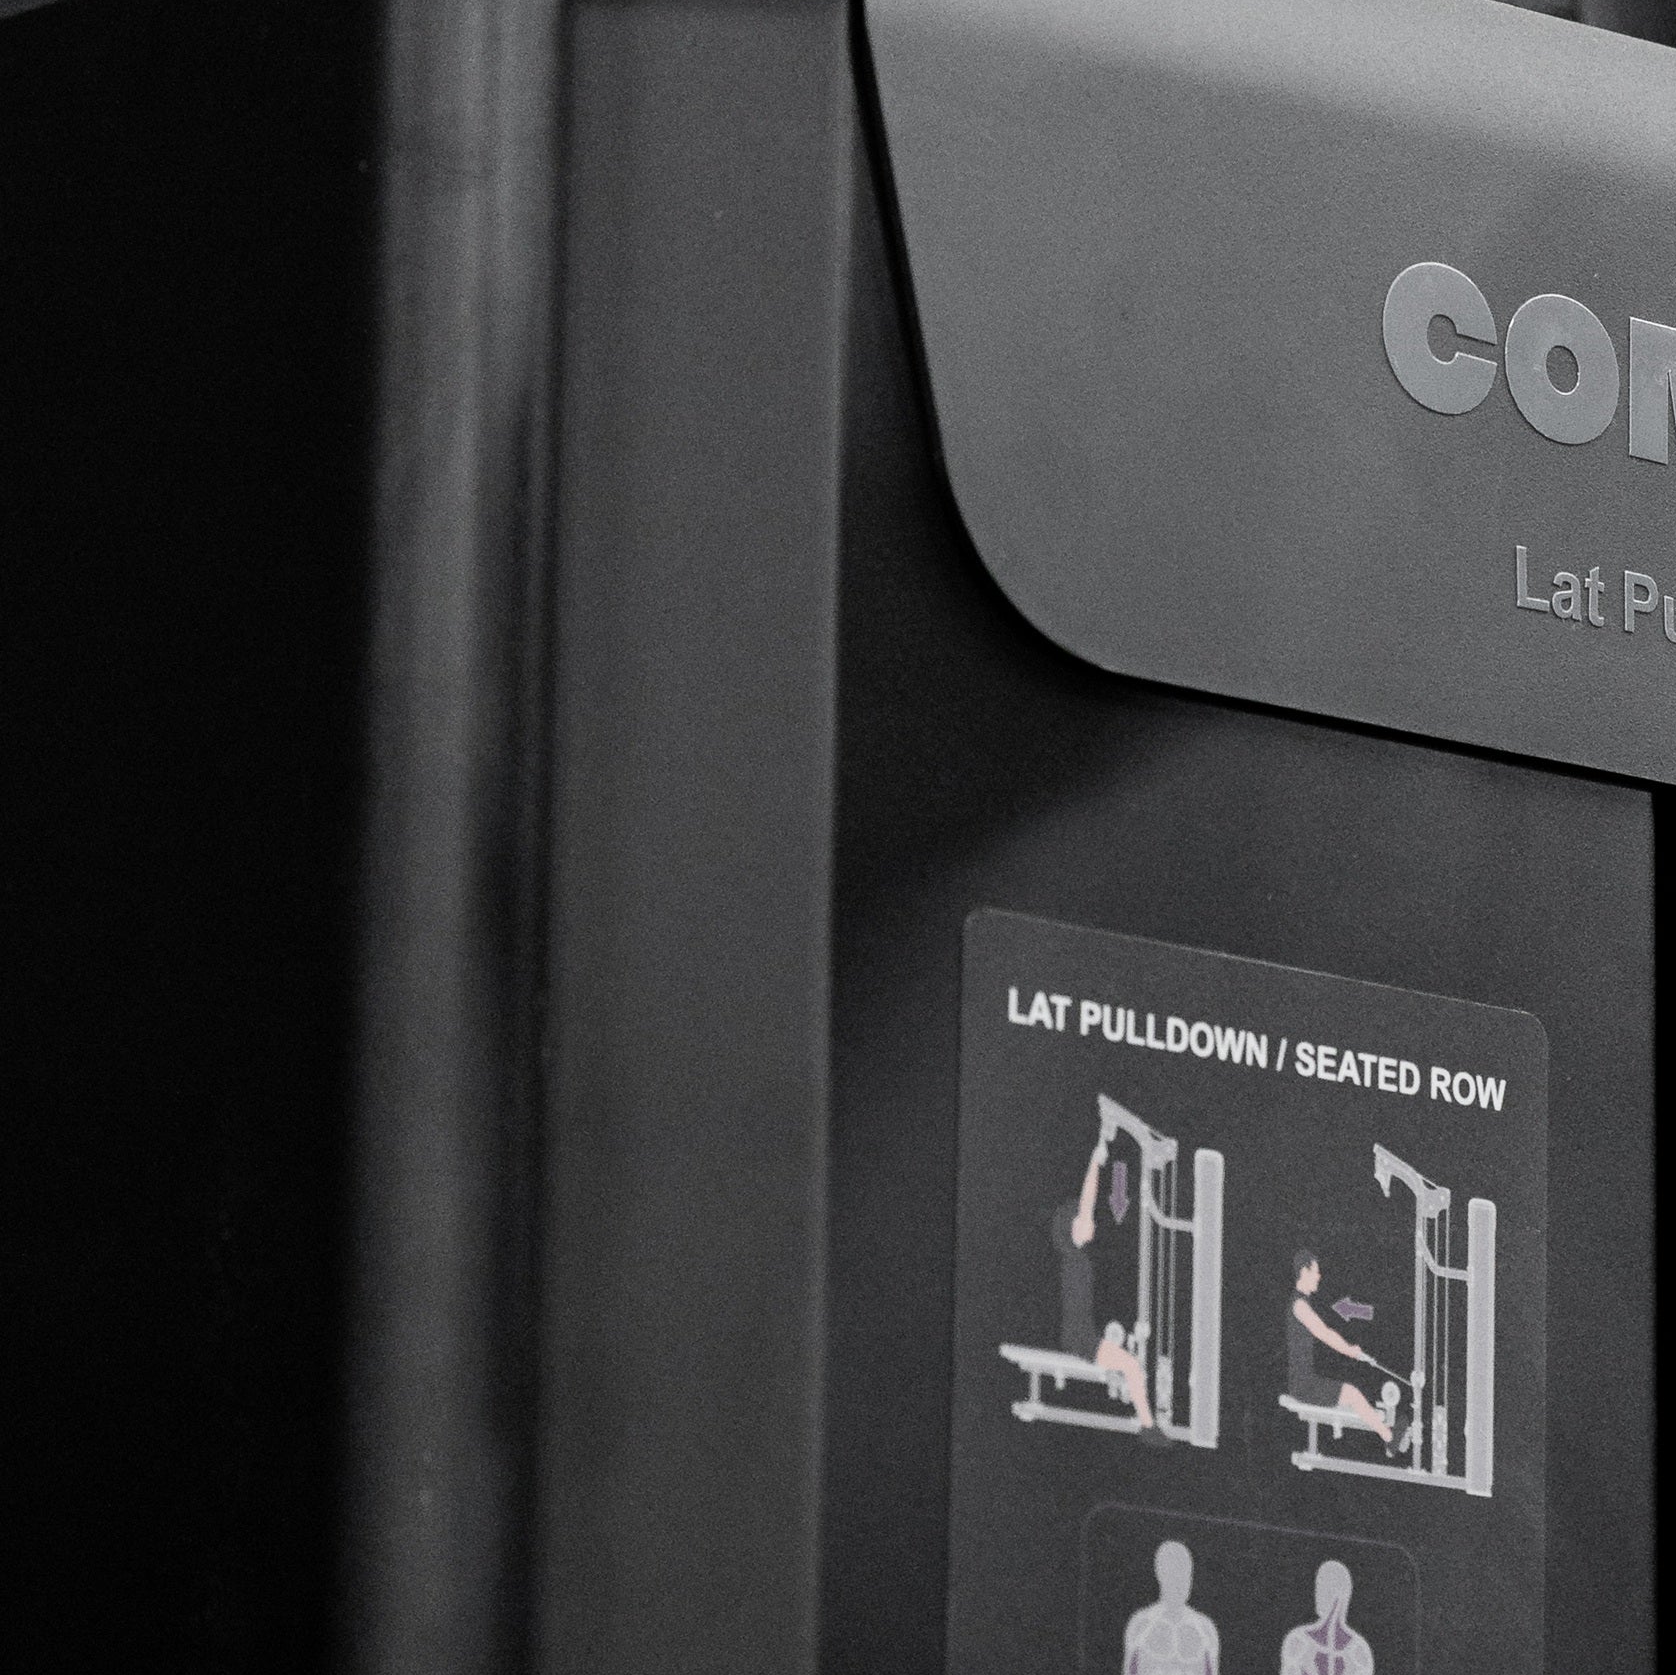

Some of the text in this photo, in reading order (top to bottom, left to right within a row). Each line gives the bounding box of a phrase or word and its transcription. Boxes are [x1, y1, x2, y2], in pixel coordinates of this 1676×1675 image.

[1515, 544, 1605, 627] Lat
[1007, 987, 1507, 1111] LAT PULLDOWN / SEATED ROW
